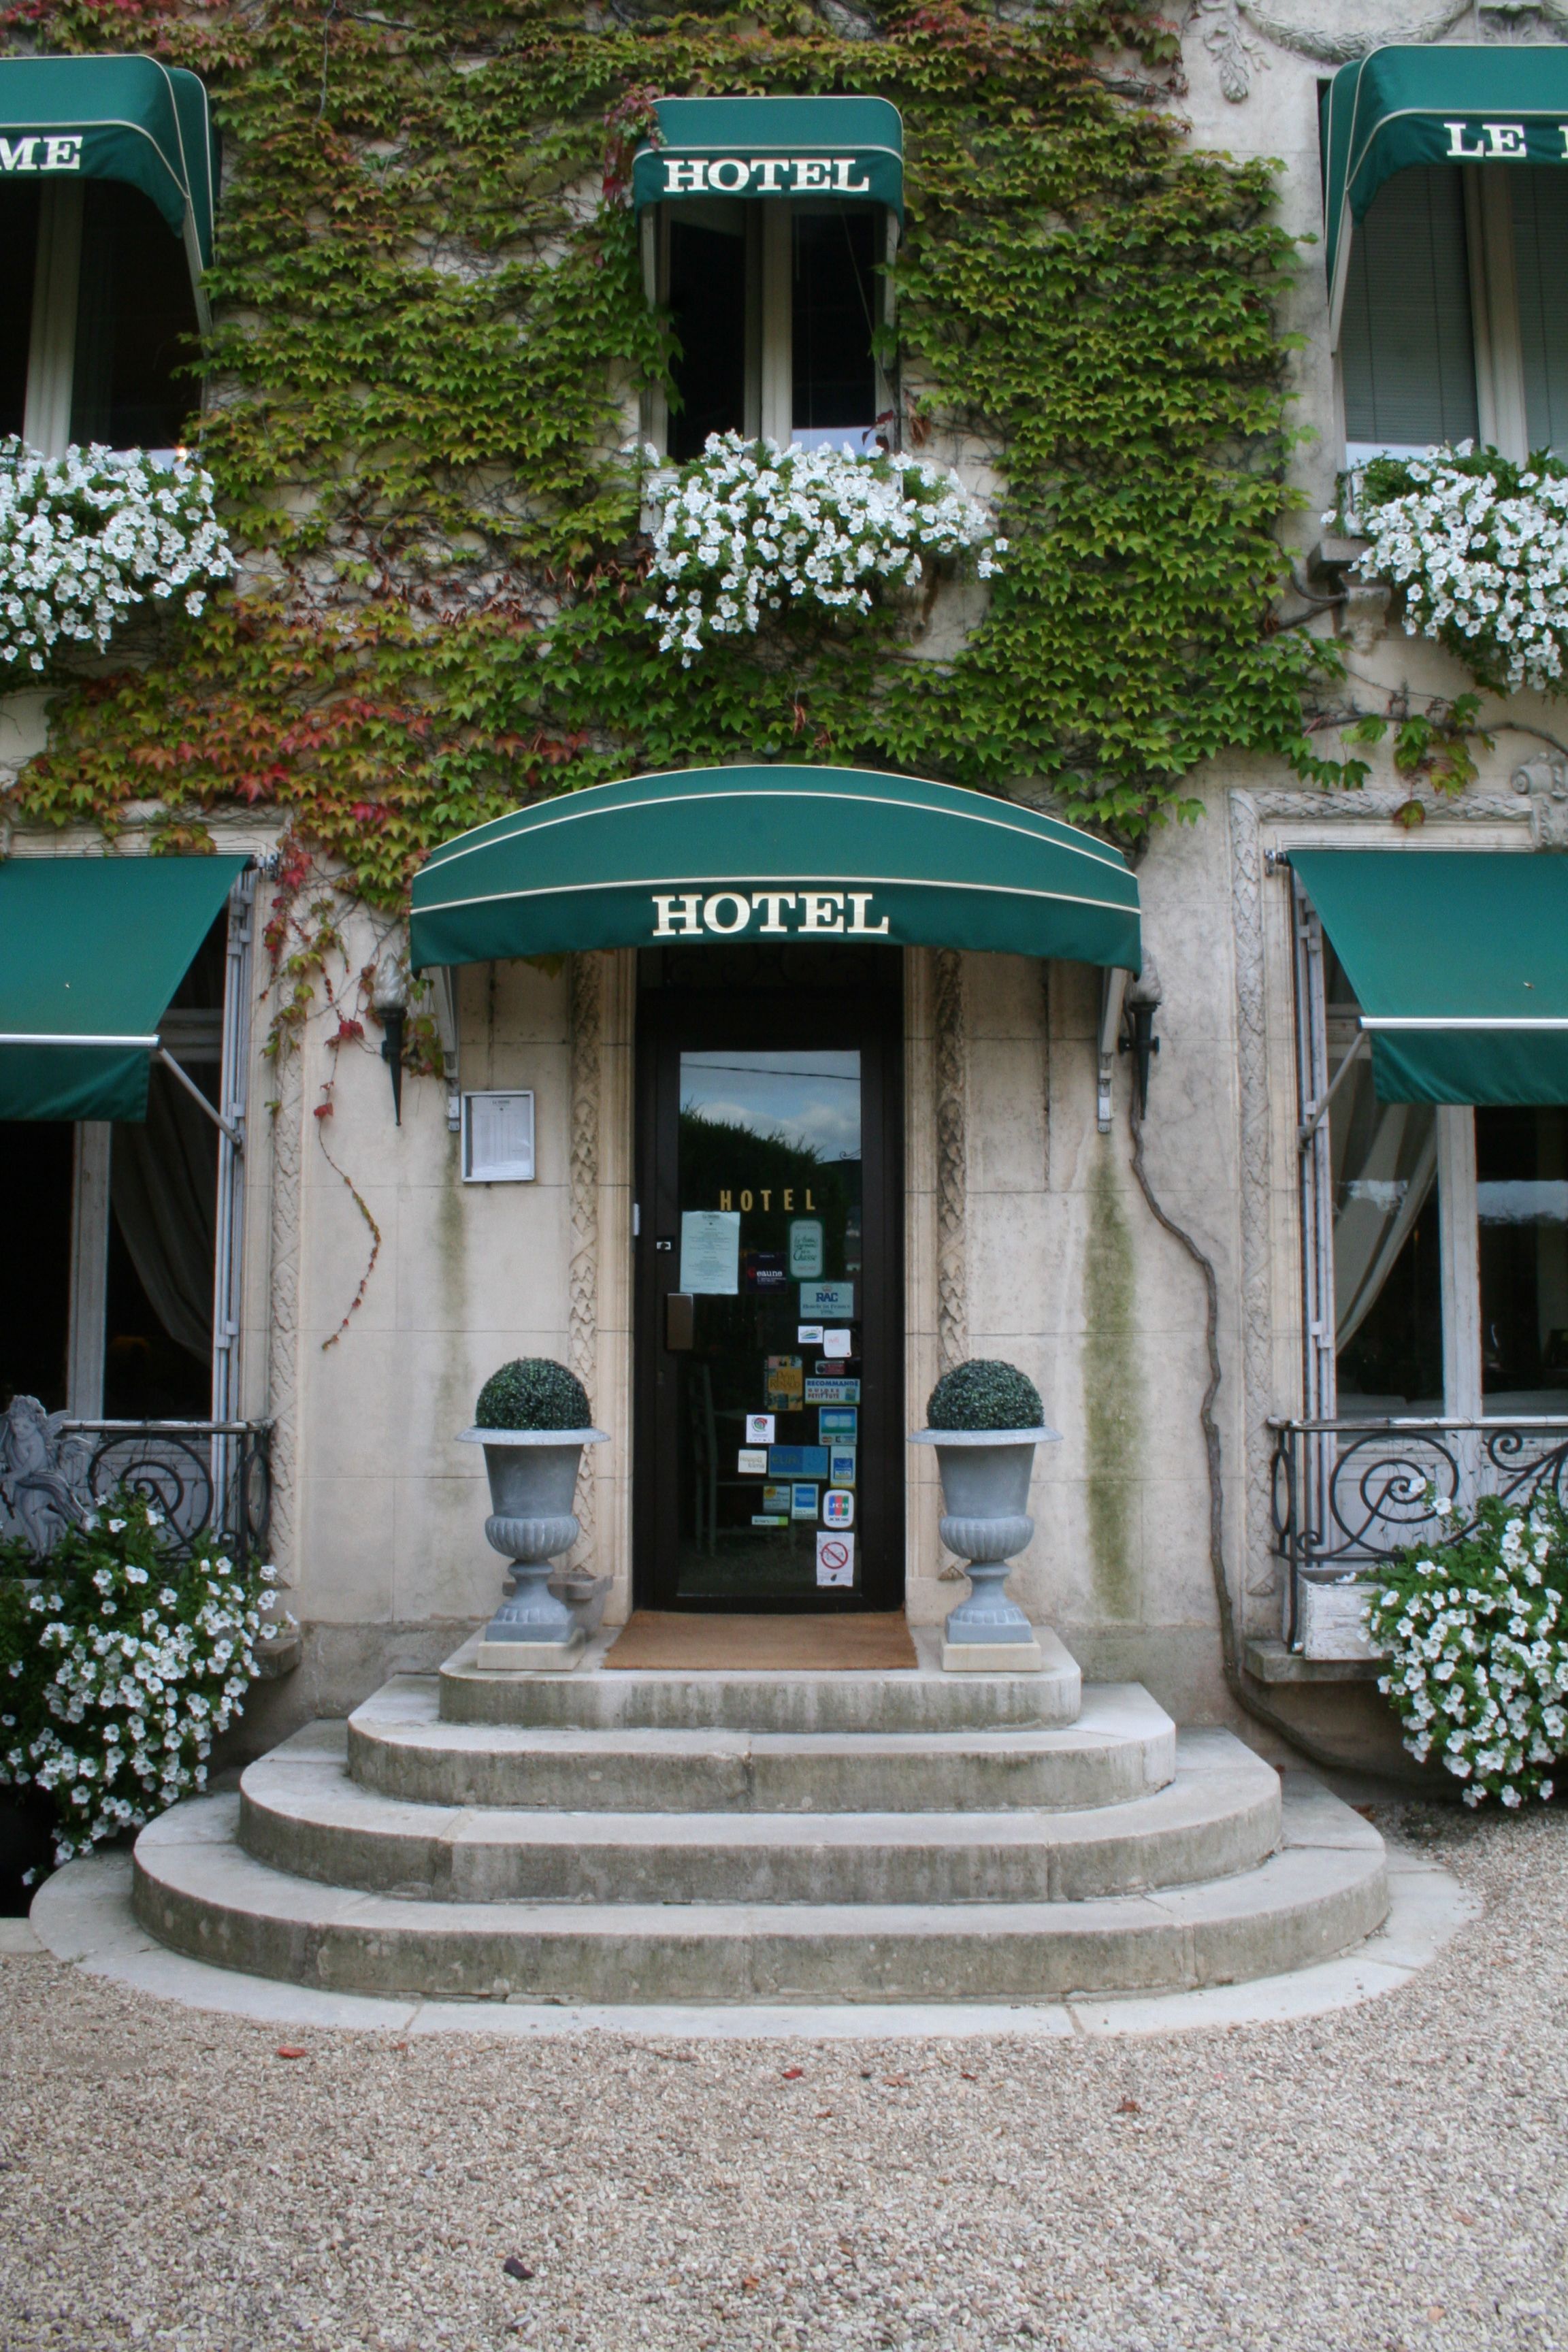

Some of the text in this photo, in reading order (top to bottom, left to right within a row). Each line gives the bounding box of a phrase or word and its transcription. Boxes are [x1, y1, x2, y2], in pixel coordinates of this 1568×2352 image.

[1443, 122, 1526, 157] LE
[663, 158, 870, 193] HOTEL
[651, 892, 889, 936] HOTEL
[719, 1189, 815, 1211] HOTEL
[816, 1292, 838, 1302] RAC
